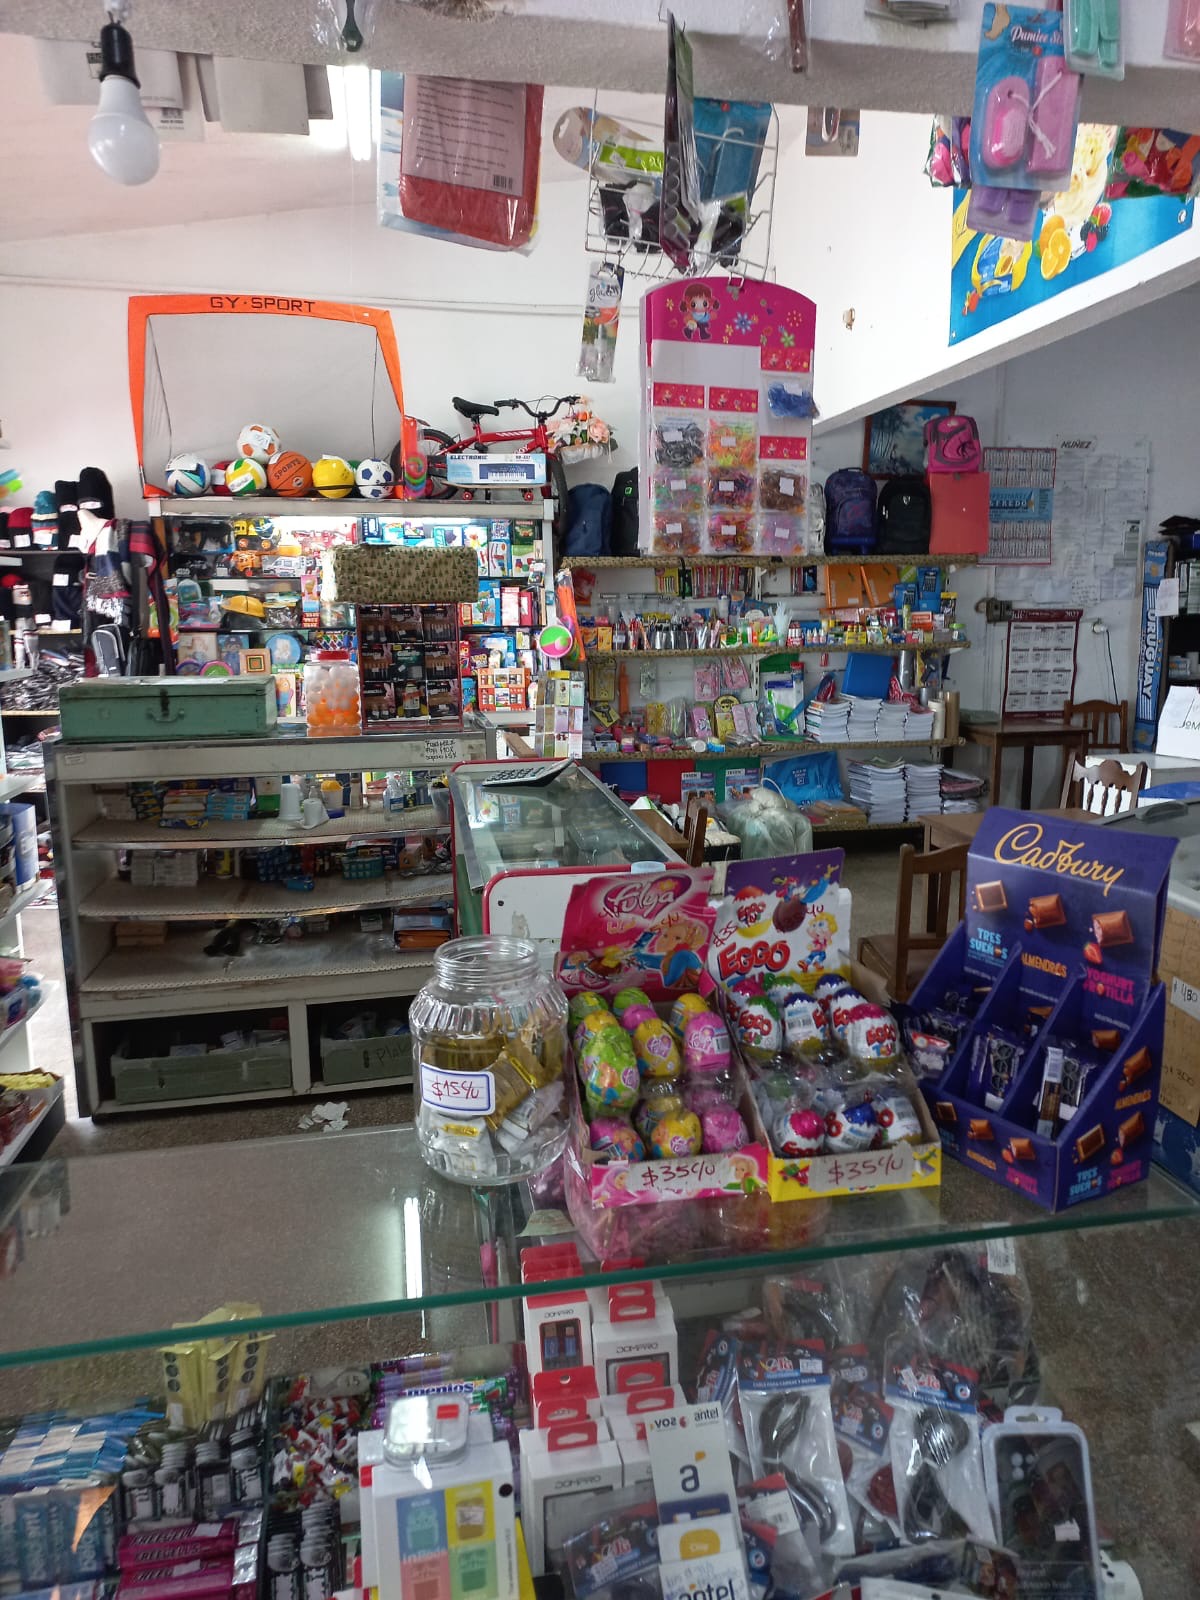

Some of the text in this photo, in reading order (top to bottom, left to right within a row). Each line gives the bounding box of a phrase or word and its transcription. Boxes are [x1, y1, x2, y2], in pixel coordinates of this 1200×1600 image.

[210, 296, 316, 312] GY SPORT
[1142, 608, 1157, 701] URUGUAY
[994, 823, 1125, 897] Cadbury
[977, 928, 1002, 945] TRES
[717, 940, 791, 981] EGGO
[739, 1010, 773, 1036] EGGO
[694, 1407, 719, 1422] antel
